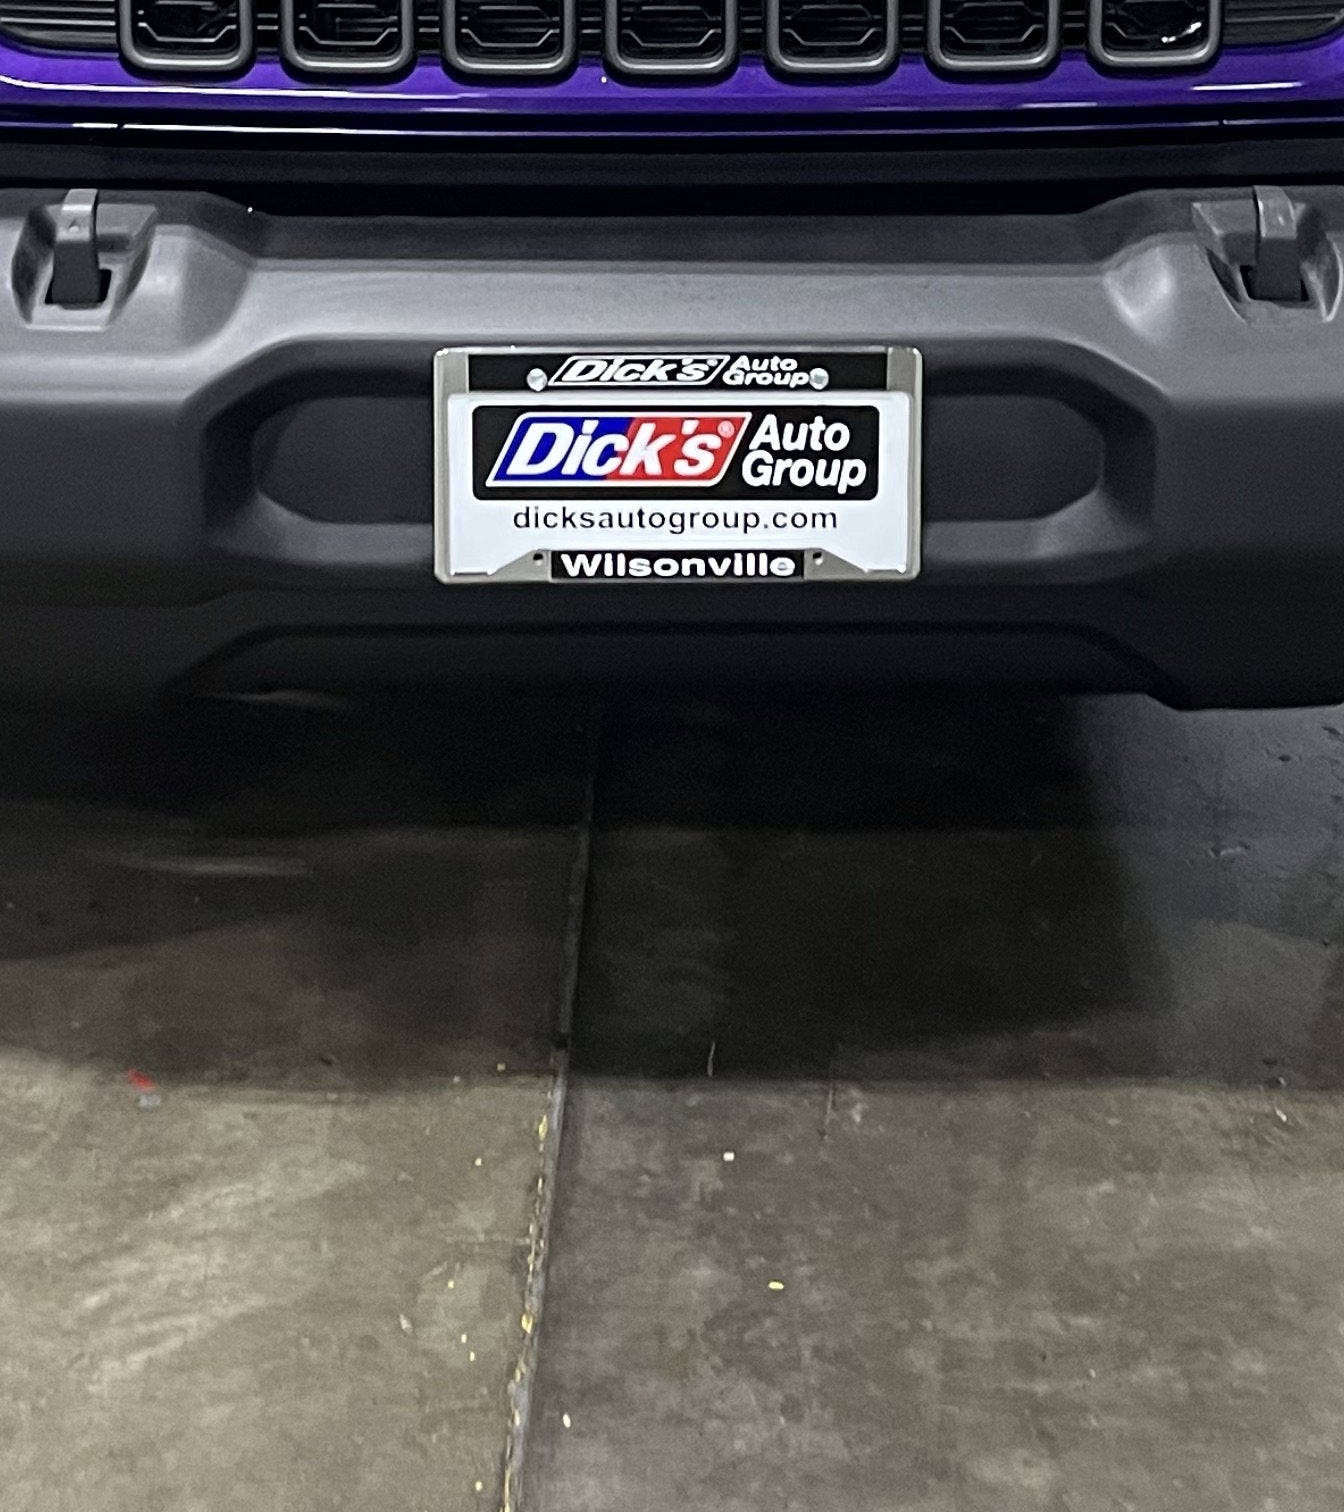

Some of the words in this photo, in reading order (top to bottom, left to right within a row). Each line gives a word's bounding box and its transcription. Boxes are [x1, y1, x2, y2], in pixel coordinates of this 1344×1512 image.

[729, 355, 798, 372] Auto
[722, 369, 810, 388] Group
[749, 414, 851, 452] Auto
[505, 419, 724, 477] Dick's
[741, 451, 867, 494] Group
[512, 506, 839, 535] dicksautogroup.com
[560, 552, 797, 578] Wilsonville
